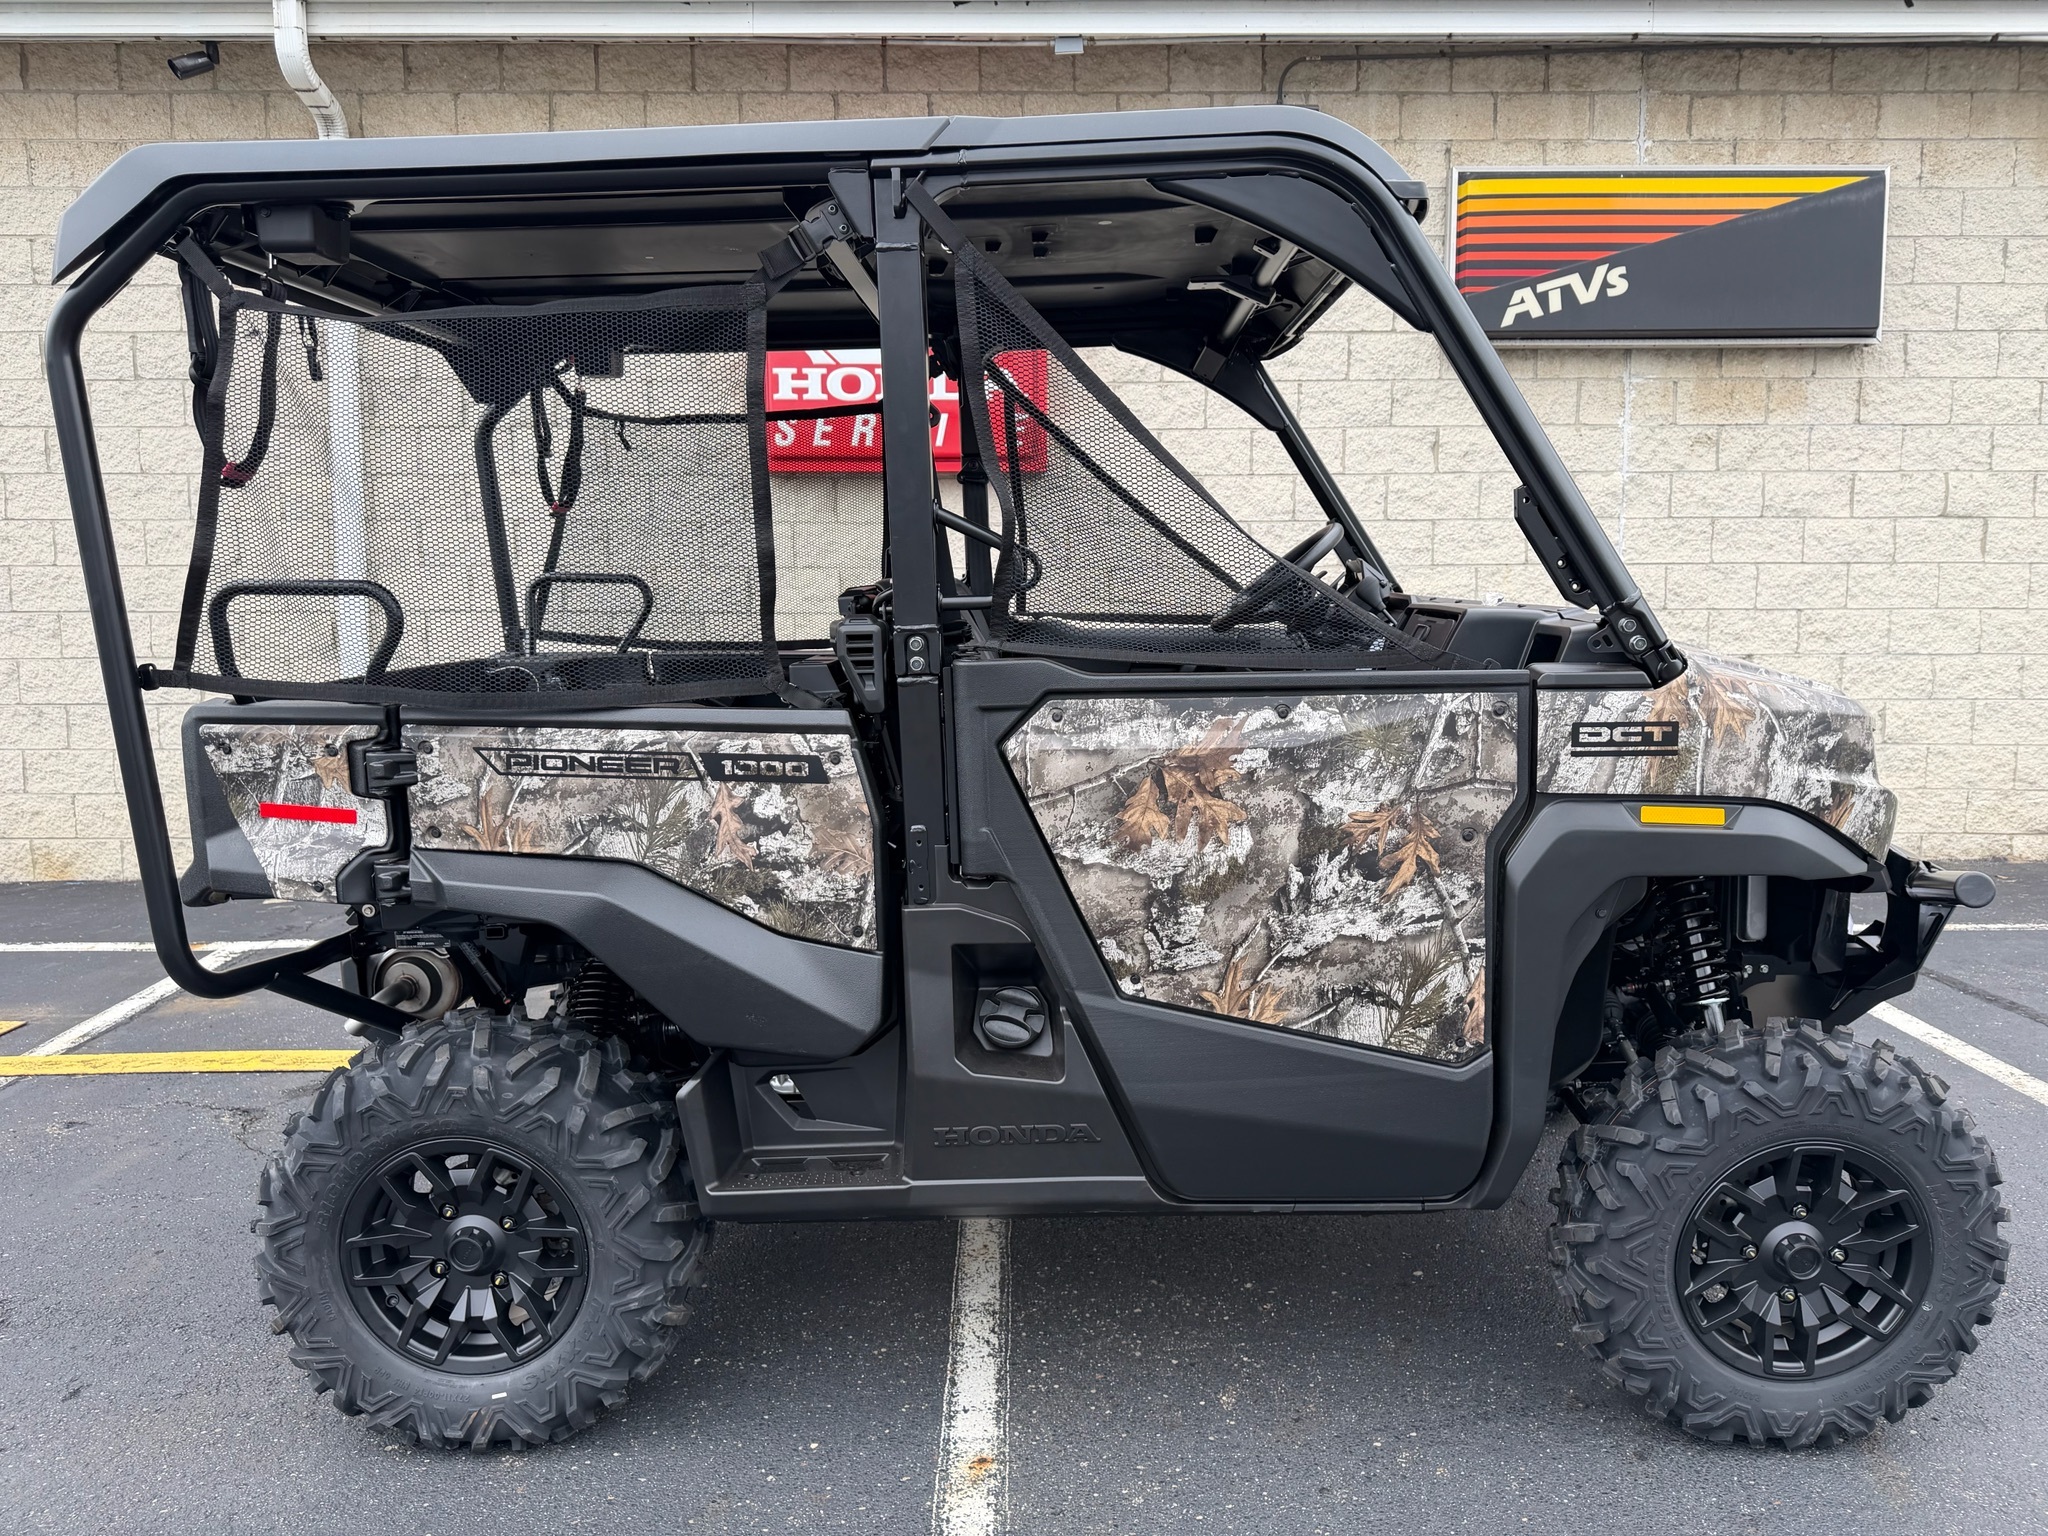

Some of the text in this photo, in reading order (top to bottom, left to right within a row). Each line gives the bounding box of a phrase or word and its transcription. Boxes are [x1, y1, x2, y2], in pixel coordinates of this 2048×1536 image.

[1501, 263, 1629, 328] ATVs
[505, 754, 810, 777] PIONEER 1000
[933, 1123, 1102, 1146] HONDA
